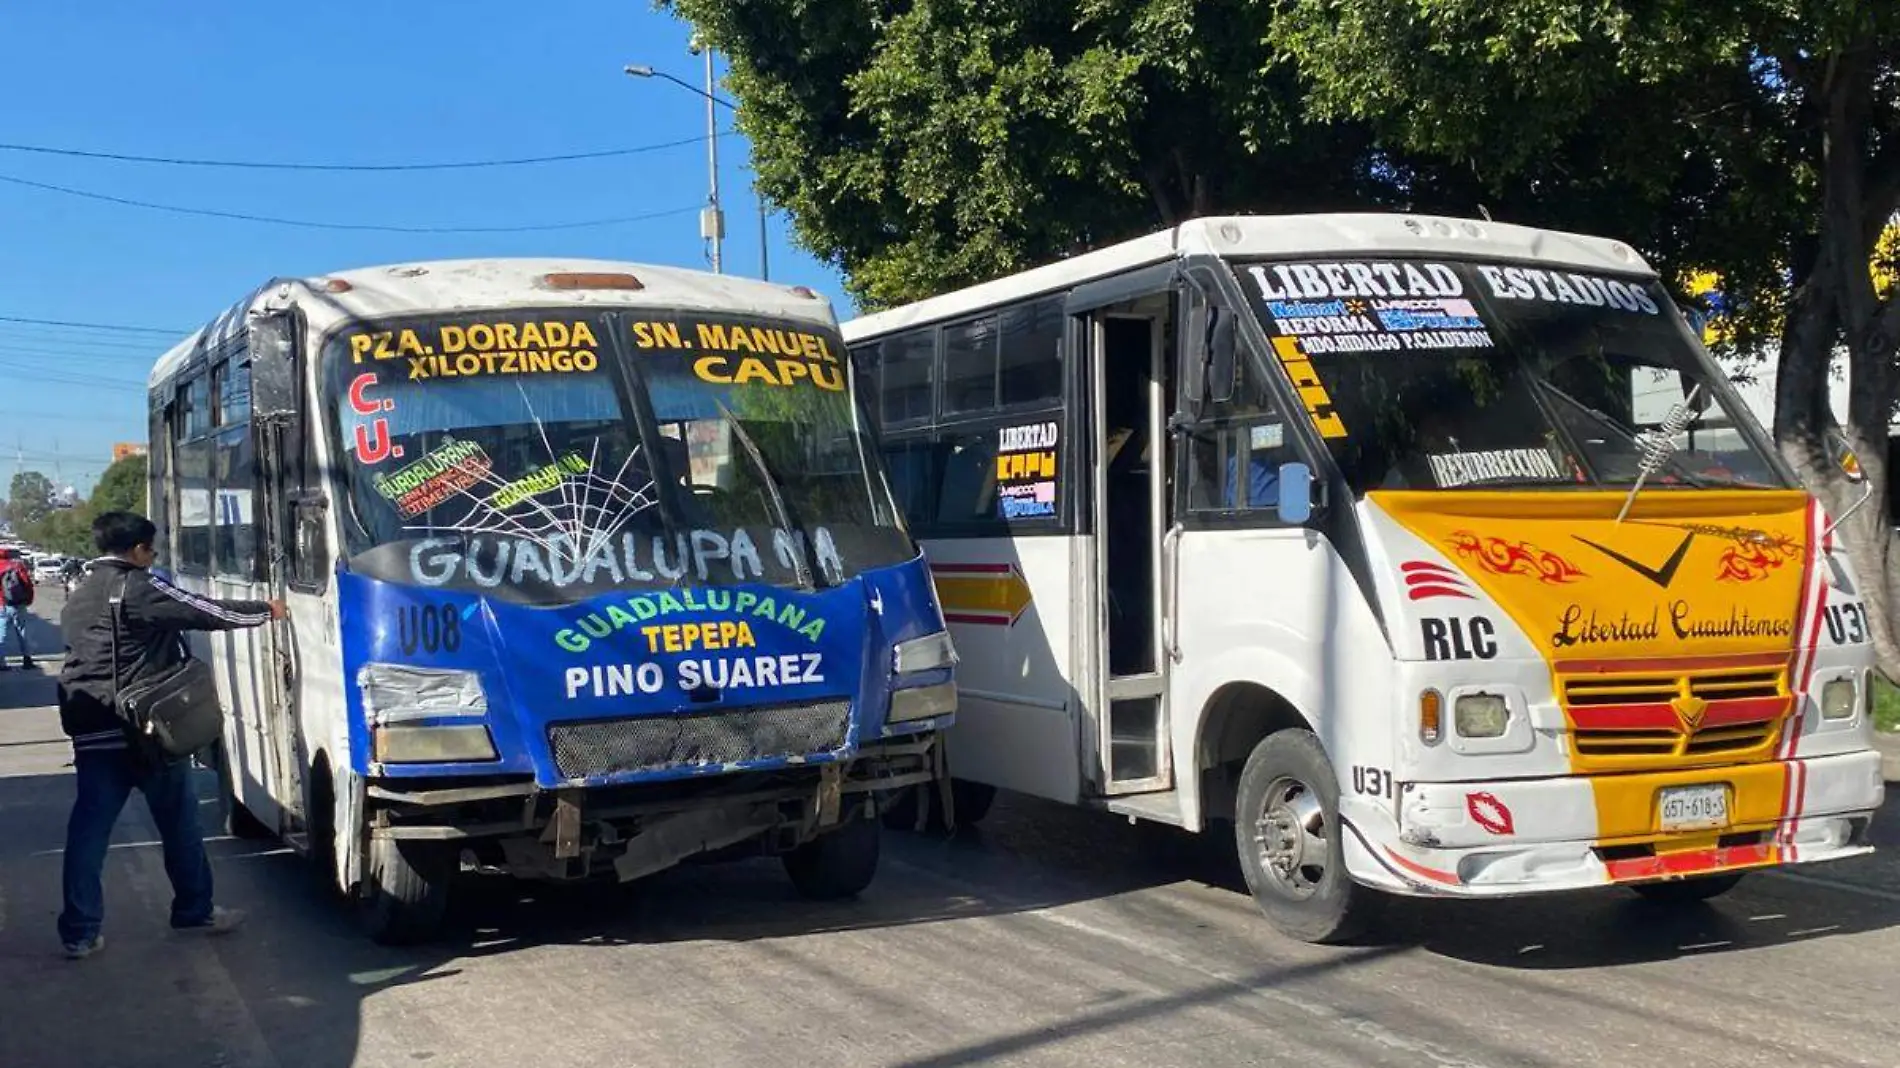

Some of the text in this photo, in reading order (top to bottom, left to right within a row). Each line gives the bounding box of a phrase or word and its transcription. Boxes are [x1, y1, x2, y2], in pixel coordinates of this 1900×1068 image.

[1248, 263, 1660, 315] LIBERTAD ESTADIOS
[351, 321, 597, 364] PZA. DORADA
[632, 322, 838, 364] SN. MANUEL
[1277, 315, 1378, 335] REFORMA
[408, 350, 597, 379] XILOTZINGO
[693, 356, 845, 391] CAPU
[999, 422, 1057, 451] LIBERTAD
[1430, 448, 1560, 488] RESURRECCION
[400, 605, 462, 656] U08
[554, 588, 827, 653] GUADALUPANA
[640, 620, 756, 653] TEPEPA
[1421, 617, 1497, 660] RLC
[1552, 599, 1793, 648] Libertad Cuauhtemoc
[565, 653, 824, 698] PINO SUAREZ
[1352, 765, 1393, 799] U31
